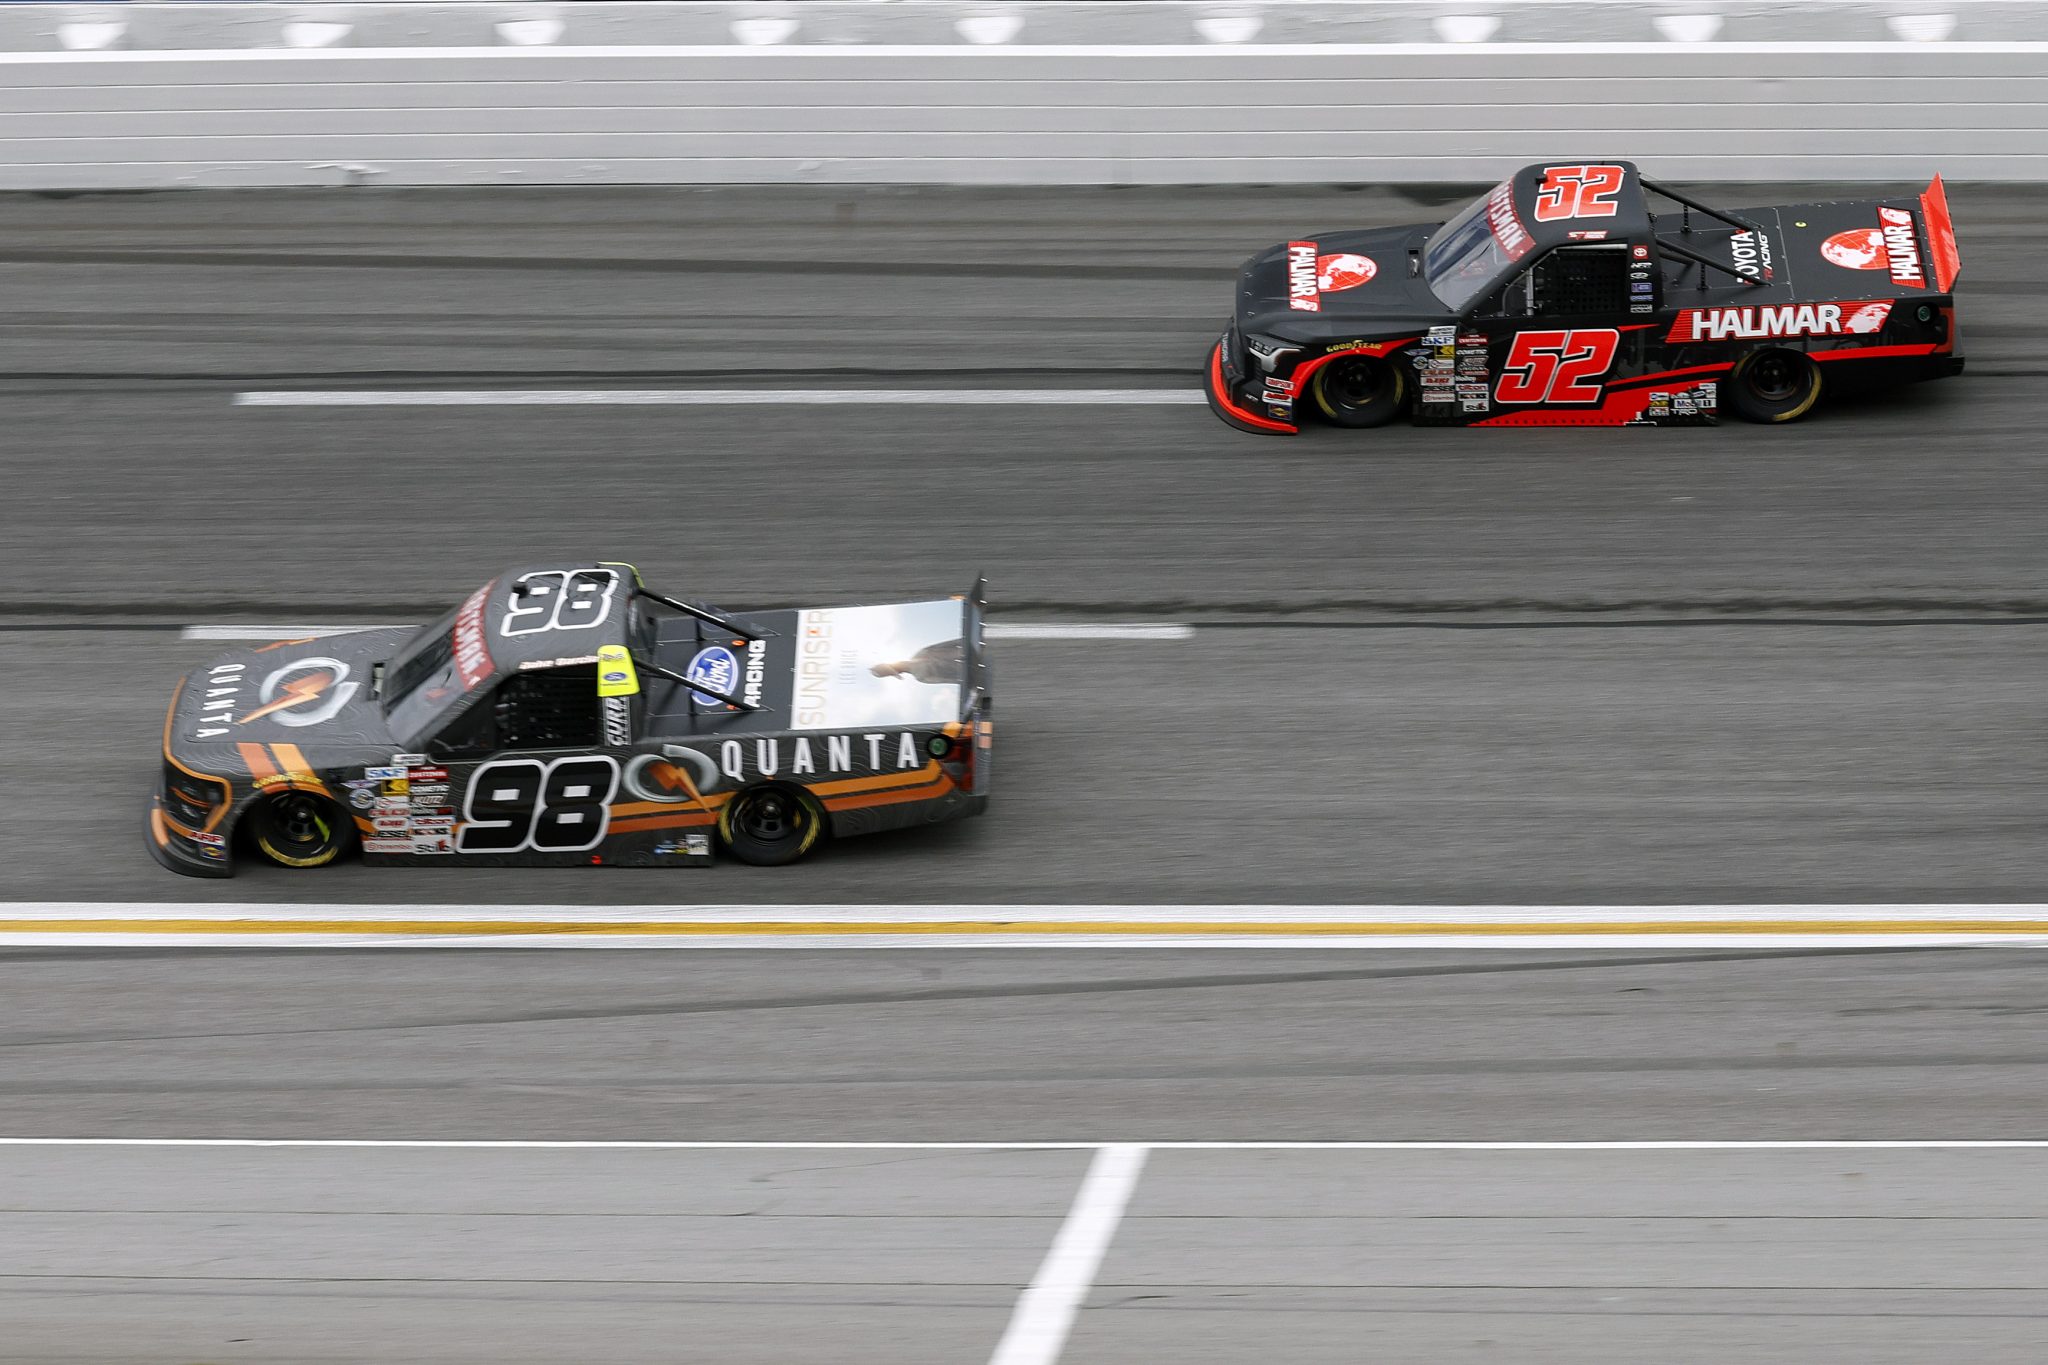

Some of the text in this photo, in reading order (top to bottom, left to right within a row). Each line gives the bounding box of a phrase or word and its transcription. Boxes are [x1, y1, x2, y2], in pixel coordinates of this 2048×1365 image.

[1489, 179, 1525, 250] AFTSMAN
[1534, 165, 1627, 223] 52
[1289, 246, 1318, 298] HALMAR
[1883, 225, 1922, 281] HALMAR
[1325, 340, 1383, 353] GOODYEAR
[1422, 337, 1454, 345] SKF
[1692, 304, 1842, 341] HALMAR
[1494, 329, 1620, 404] 52
[501, 568, 620, 637] 98
[694, 657, 731, 694] Ford
[800, 610, 834, 726] SUNRISER
[196, 663, 246, 738] QUANTA
[722, 732, 922, 783] QUANTA
[455, 755, 622, 854] 98
